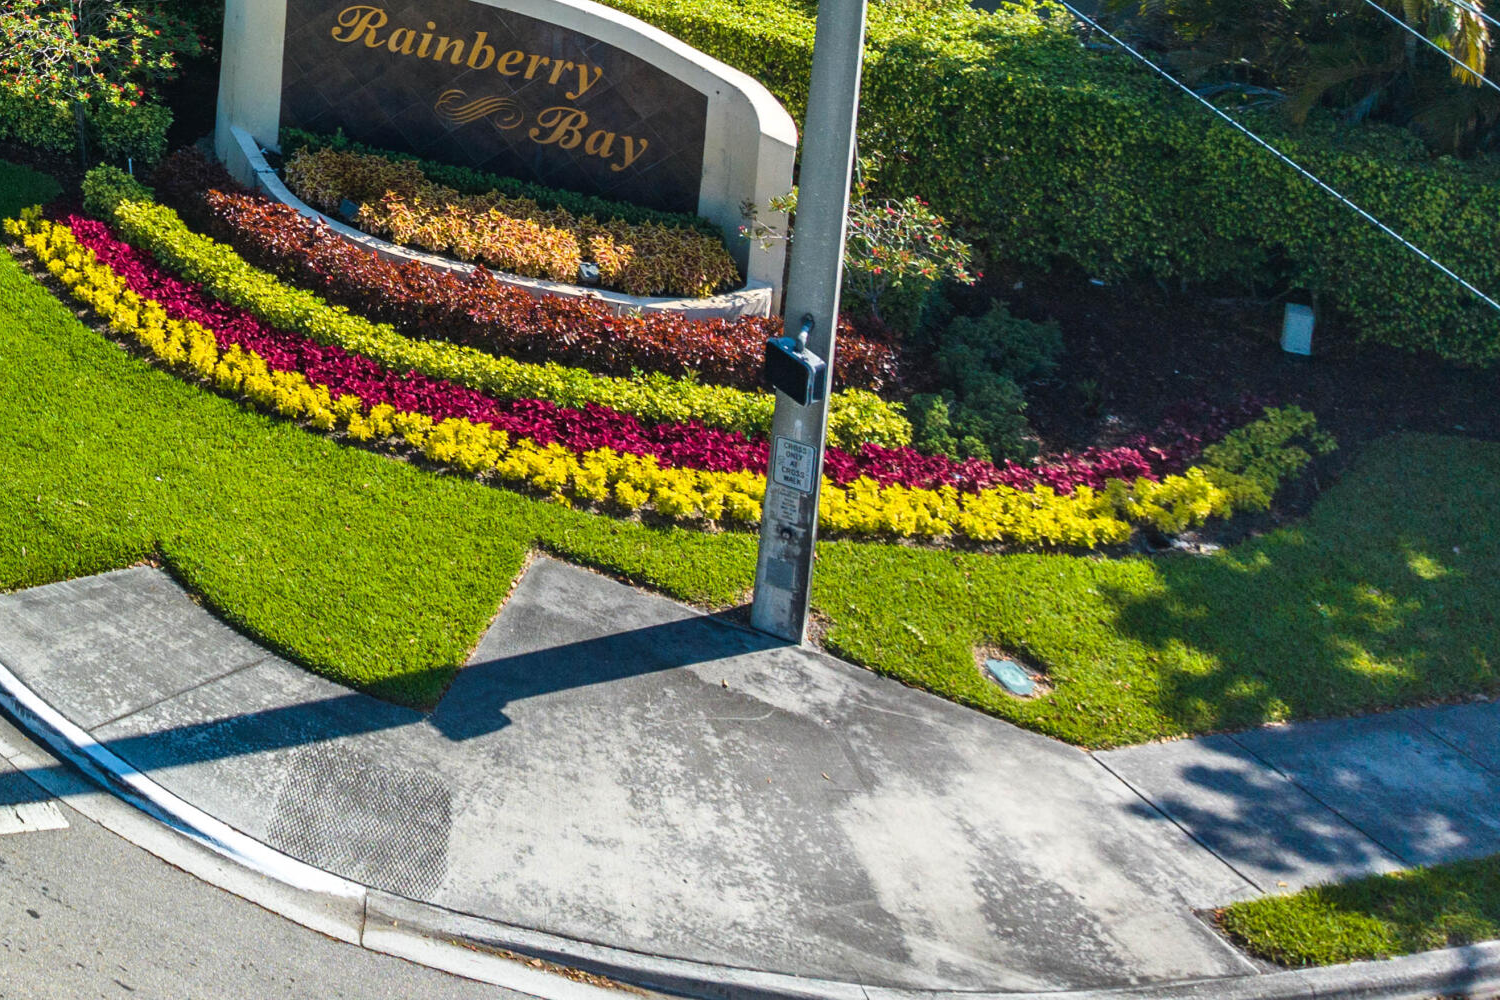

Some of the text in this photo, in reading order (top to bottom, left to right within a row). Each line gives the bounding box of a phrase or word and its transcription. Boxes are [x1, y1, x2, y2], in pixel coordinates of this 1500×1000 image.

[331, 5, 603, 100] Rainberry
[528, 106, 649, 172] Bay
[784, 442, 807, 454] CROSS
[786, 451, 803, 461] ONLY
[782, 466, 805, 479] CROSS
[783, 475, 802, 486] WALK
